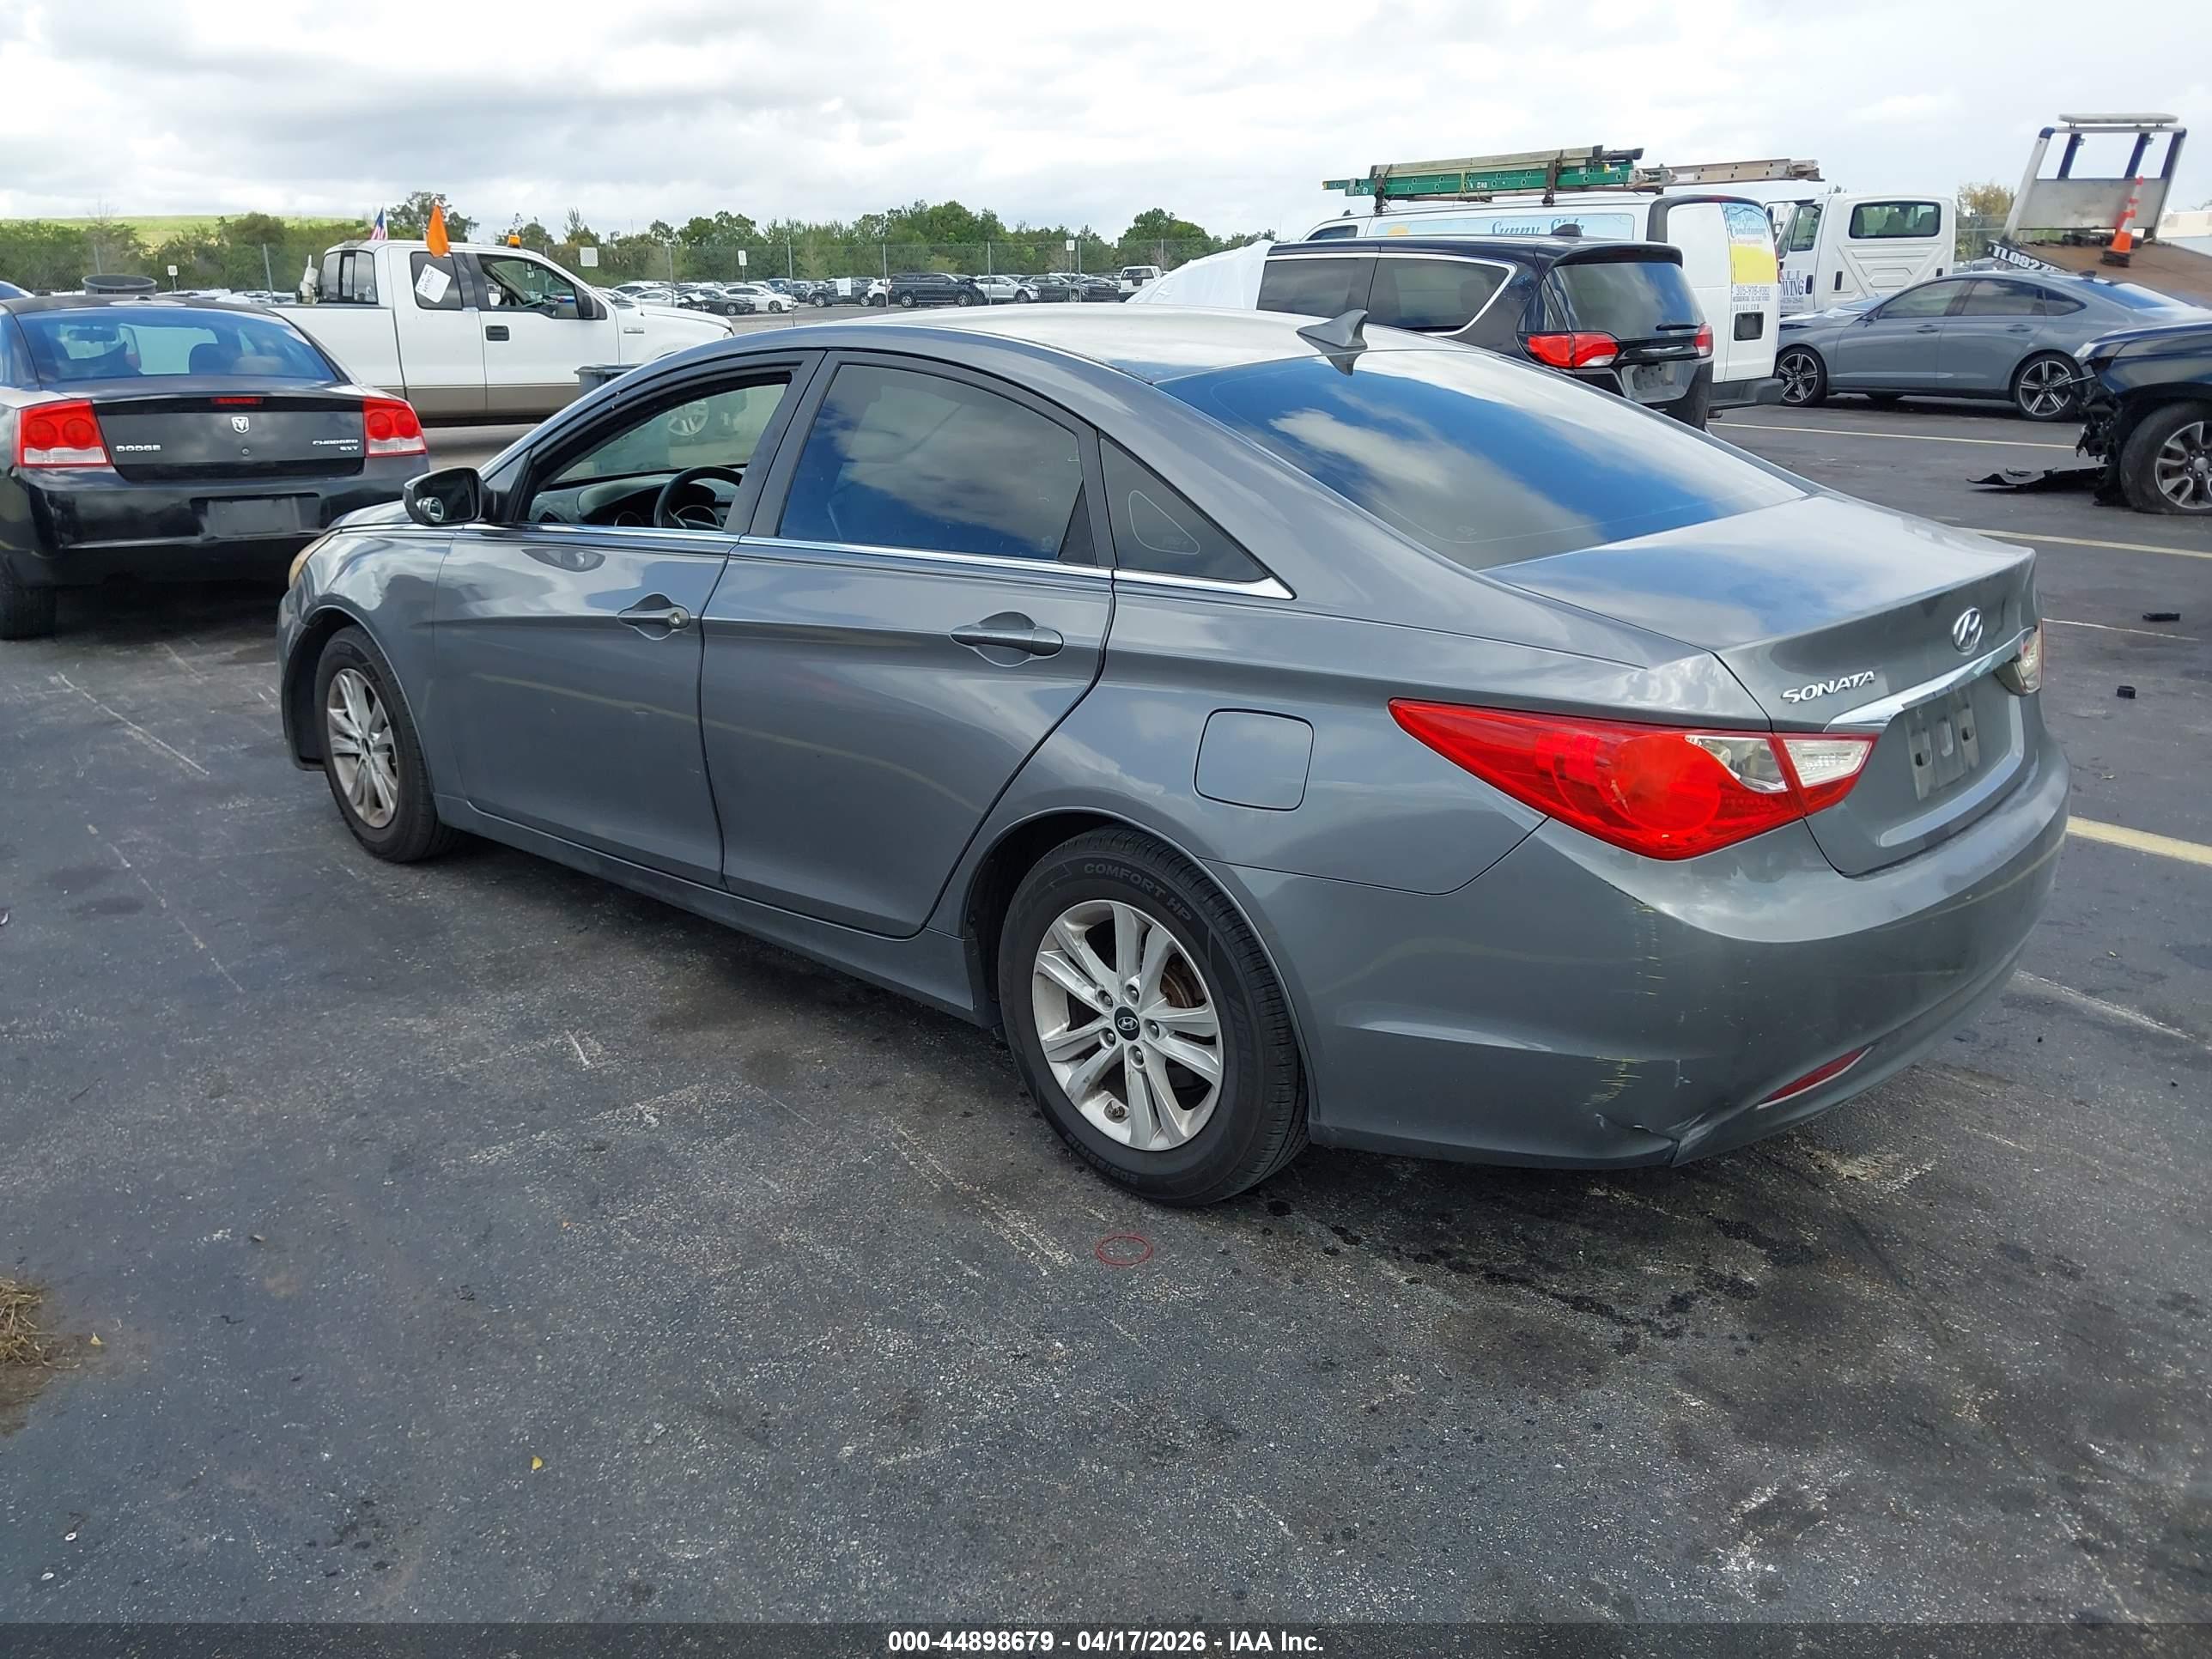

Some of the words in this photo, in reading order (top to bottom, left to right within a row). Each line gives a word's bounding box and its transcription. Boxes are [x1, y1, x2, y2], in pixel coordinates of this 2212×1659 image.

[1782, 671, 1875, 703] SONATA
[1084, 863, 1166, 898] COMFORT
[1166, 897, 1192, 921] HP
